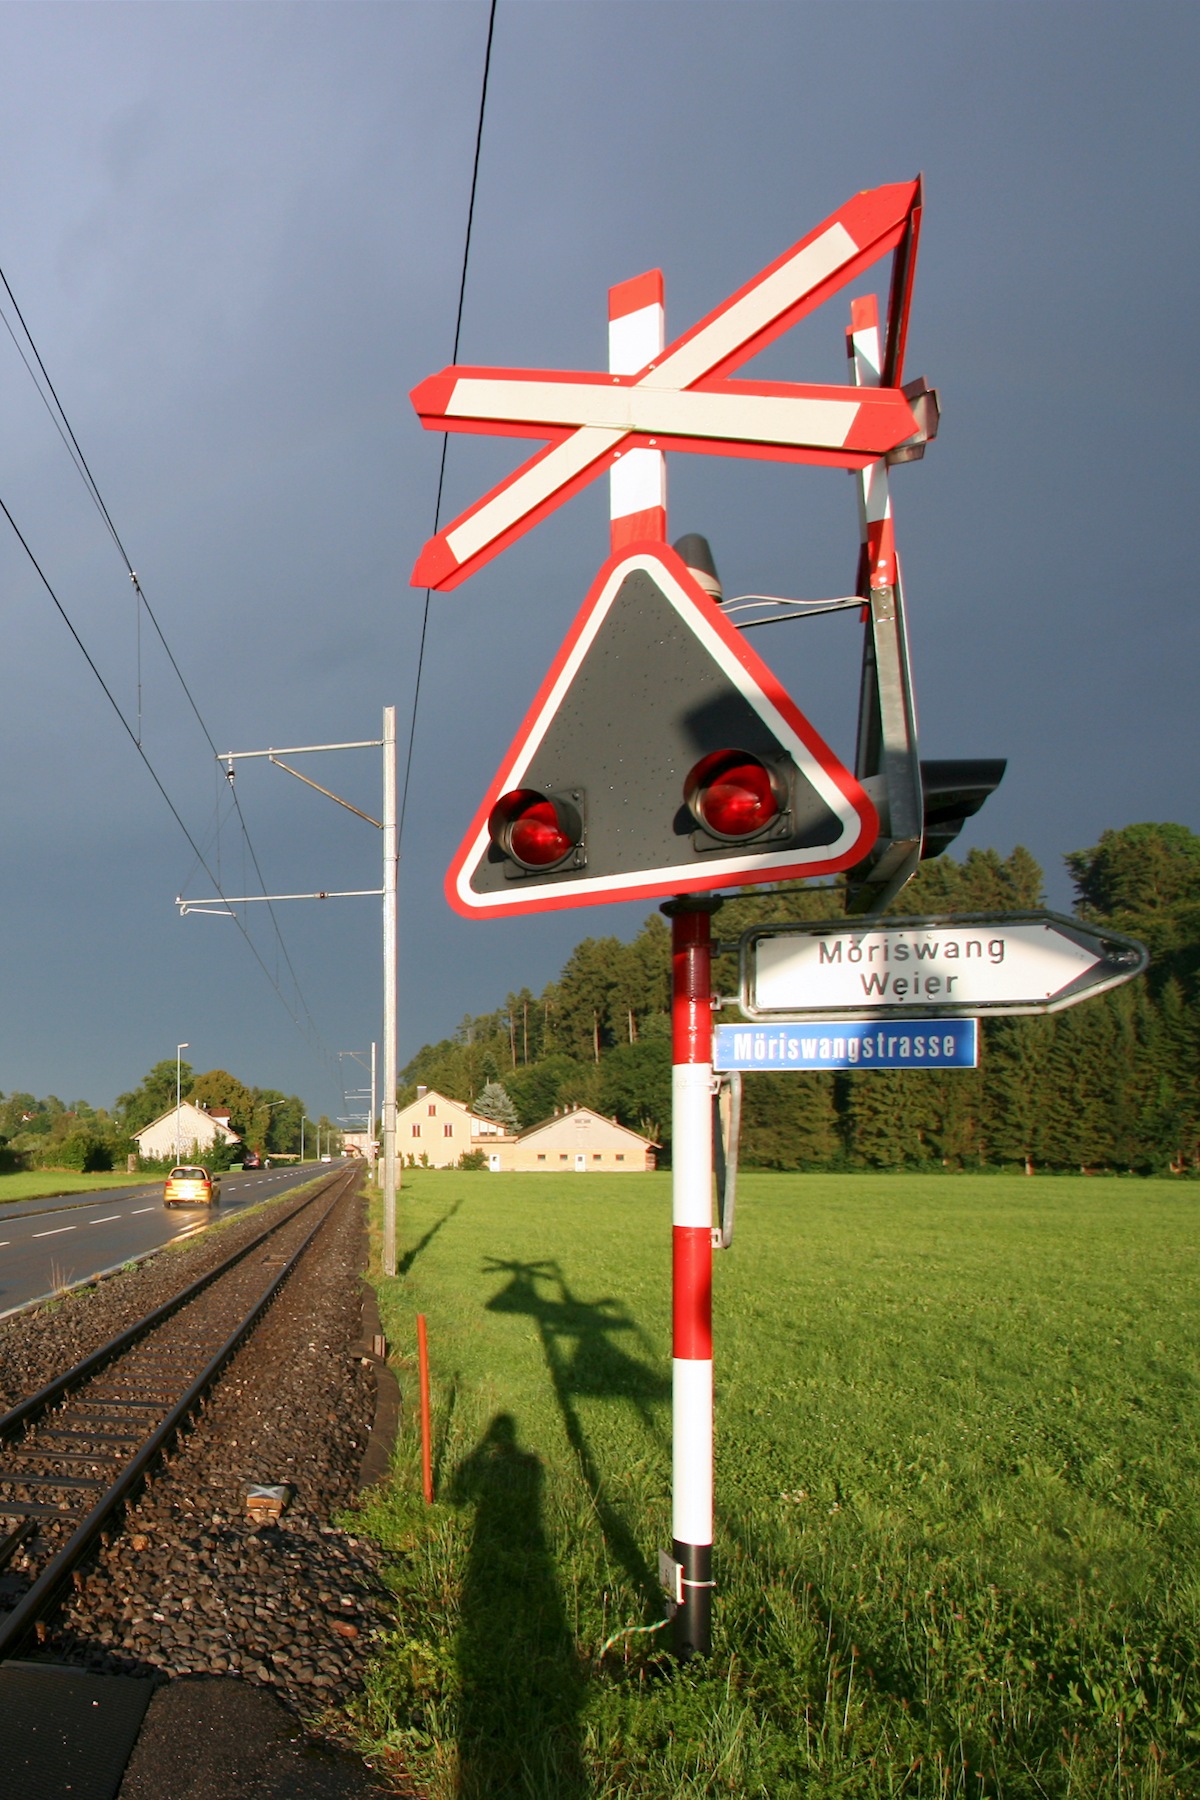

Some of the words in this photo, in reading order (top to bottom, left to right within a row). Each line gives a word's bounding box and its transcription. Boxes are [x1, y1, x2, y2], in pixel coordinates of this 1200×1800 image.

[819, 937, 1005, 964] Möriswang
[861, 972, 958, 995] Weier
[734, 1032, 955, 1063] Möriswangstrasse
